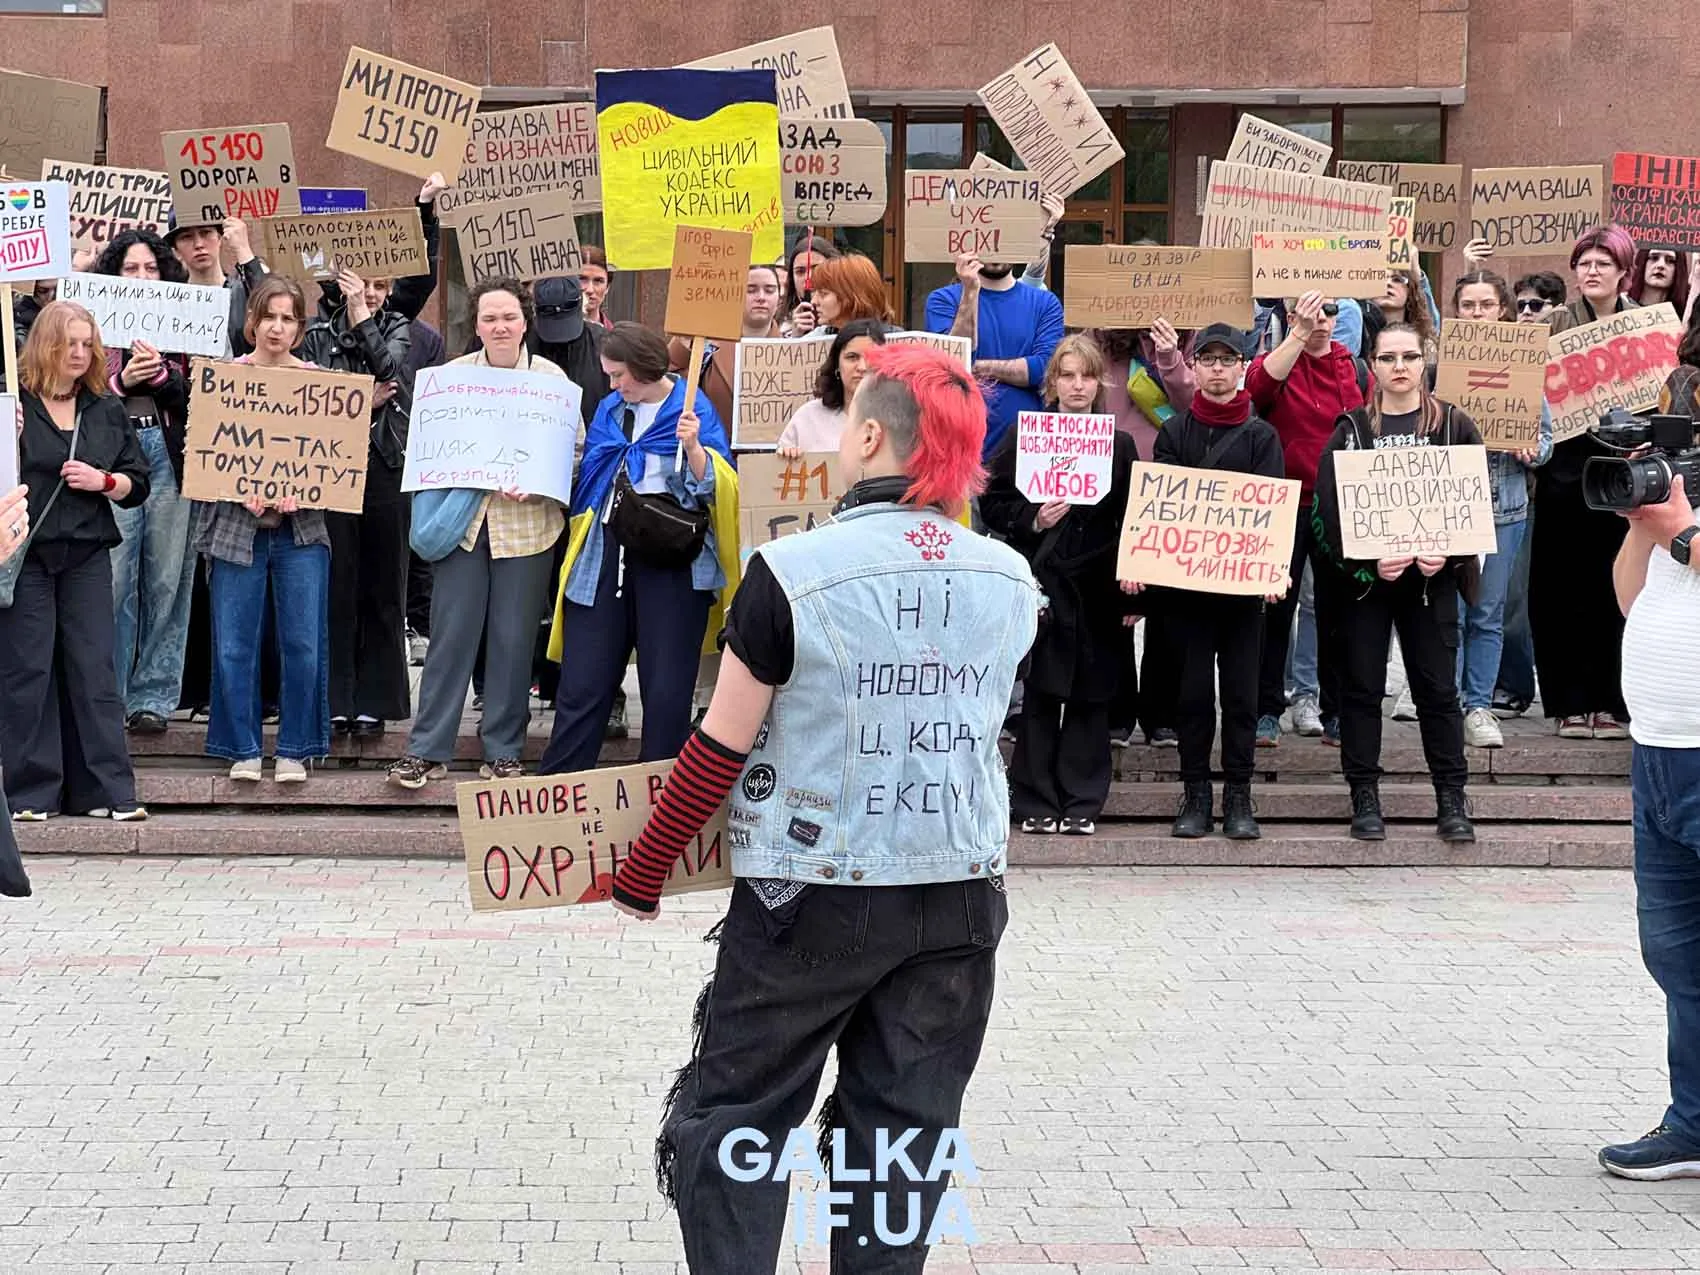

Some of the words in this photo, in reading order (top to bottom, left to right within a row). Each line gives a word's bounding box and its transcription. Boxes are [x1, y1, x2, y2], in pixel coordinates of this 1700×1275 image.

[344, 58, 394, 101] МИ
[394, 73, 475, 127] ПРОТИ
[357, 104, 439, 159] 15150
[467, 112, 550, 141] РЖАВА
[556, 106, 589, 133] НЕ
[610, 106, 675, 151] НОВИЙ
[1246, 122, 1262, 137] ВИ
[180, 132, 263, 166] 15150
[485, 132, 597, 163] ВИЗНАЧАТИ
[642, 137, 757, 170] ЦИВІЛЬНИЙ
[181, 166, 259, 190] ДОРОГА
[280, 164, 291, 184] В
[508, 160, 557, 185] КОЛИ
[561, 157, 599, 179] МЕНІ
[783, 154, 841, 176] СОЮЗ
[1338, 164, 1400, 183] КРАСТИ
[666, 168, 737, 193] КОДЕКС
[794, 181, 873, 201] ВПЕРЕД
[907, 175, 1039, 208] ДЕМОКРАТІЯ
[1398, 181, 1457, 203] ПРАВА
[1472, 180, 1538, 205] МАМА
[1539, 178, 1593, 201] ВАША
[69, 191, 171, 223] АЛИШТЕ
[659, 190, 751, 218] УКРАЇНИ
[950, 204, 995, 225] ЧУЄ
[274, 218, 403, 239] НАГОЛОСУВАЛИ,
[294, 241, 319, 252] НАМ
[331, 233, 376, 249] ПОТІМ
[389, 231, 408, 245] ЦЕ
[461, 207, 536, 249] 15150
[948, 228, 1001, 254] ВСІХ!
[335, 247, 419, 269] РОЗГРІБАТИ
[530, 238, 582, 276] НАЗАД
[1108, 251, 1136, 266] ЩО
[1141, 252, 1161, 266] ЗА
[1165, 251, 1202, 264] ЗВІР
[1132, 273, 1183, 289] ВАША
[1256, 267, 1266, 278] А
[63, 279, 81, 299] ВИ
[87, 281, 144, 299] БАЧИЛИ
[89, 309, 225, 344] ЛОСУВАЛИ?
[1448, 323, 1537, 344] ДОМАШНЄ
[1560, 315, 1641, 355] БОРЕМОСЬ
[1646, 311, 1664, 327] ЗА
[744, 341, 828, 367] ГРОМАДА
[1443, 344, 1547, 366] НАСИЛЬСТВО
[741, 370, 792, 393] ДУЖЕ
[220, 396, 298, 417] ЧИТАЛИ
[293, 383, 365, 420] 15150
[739, 400, 793, 425] ПРОТИ
[1460, 395, 1497, 413] ЧАС
[1504, 397, 1528, 413] НА
[212, 421, 265, 449] МИ
[1020, 414, 1037, 433] МИ
[1040, 414, 1054, 433] НЕ
[1058, 415, 1113, 436] МОСКАЛІ
[195, 450, 265, 476] ТОМУ
[271, 461, 309, 479] МИ
[314, 464, 363, 489] ТУТ
[1368, 449, 1452, 478] ДАВАЙ
[236, 476, 321, 503] СТОЇМО
[1027, 470, 1098, 498] ЛЮБОВ
[1140, 472, 1189, 500] МИ
[1195, 478, 1229, 502] НЕ
[1139, 499, 1197, 523] АБИ
[1204, 506, 1272, 529] МАТИ
[1353, 509, 1394, 539] ВСЕ
[857, 662, 989, 699] НОВОМУ
[475, 783, 601, 820] ПАНОВЕ,
[615, 779, 630, 810] А
[582, 821, 604, 835] НЕ
